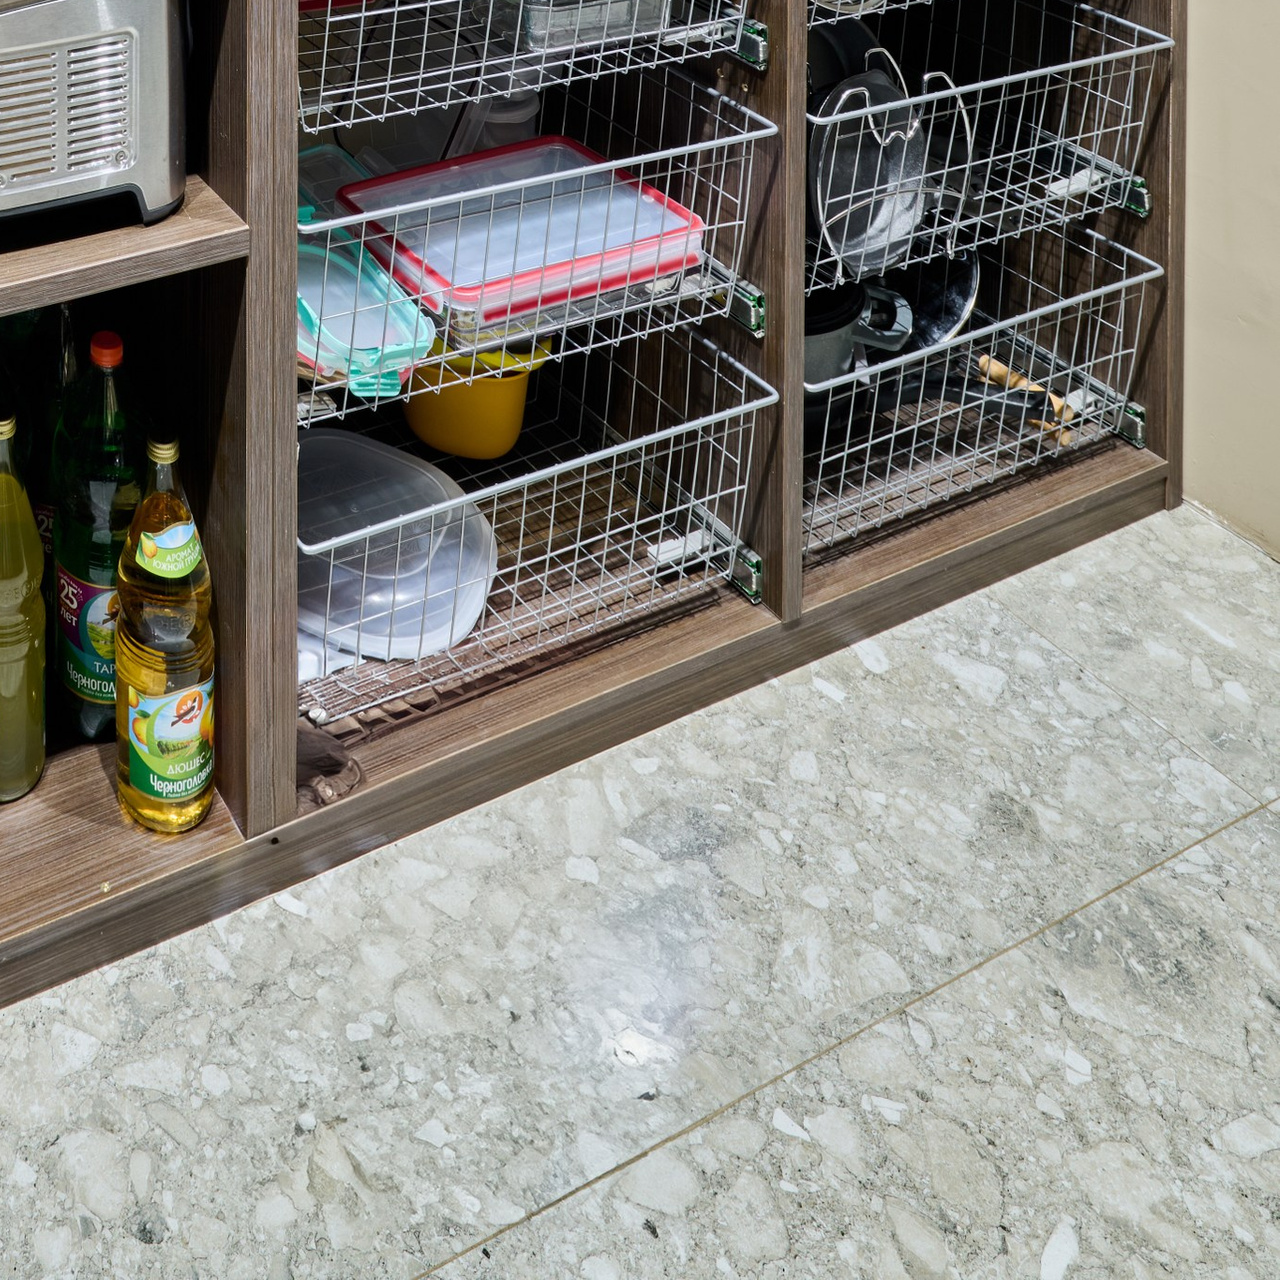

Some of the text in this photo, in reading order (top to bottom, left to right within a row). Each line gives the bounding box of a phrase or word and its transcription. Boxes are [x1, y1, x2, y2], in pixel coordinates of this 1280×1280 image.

[152, 544, 200, 572] ЮЖНОЙ ГРУШИ
[165, 543, 194, 562] АРОМАТ
[60, 578, 78, 610] 25
[60, 608, 78, 627] лет
[66, 660, 116, 693] Черногол
[93, 661, 116, 675] ТАР
[166, 751, 206, 775] ДЮШЕС
